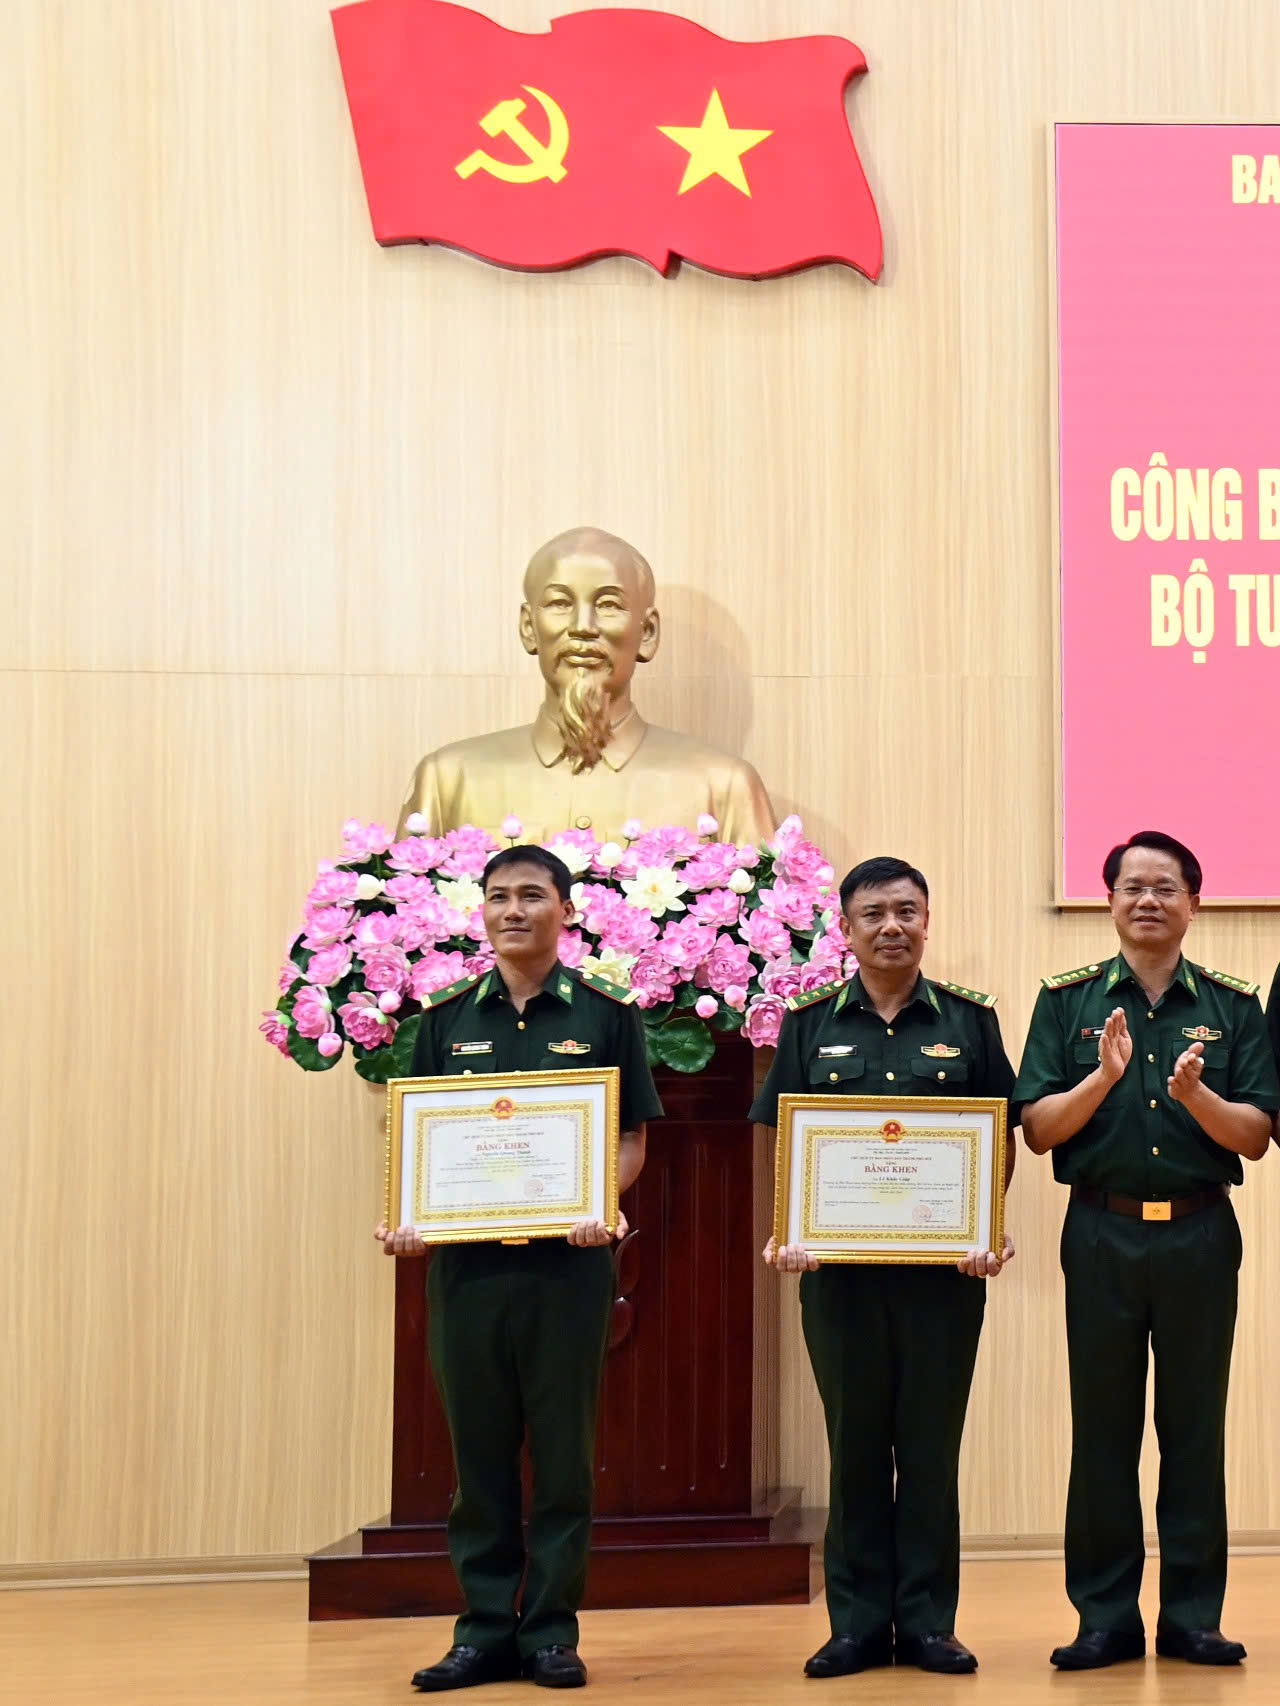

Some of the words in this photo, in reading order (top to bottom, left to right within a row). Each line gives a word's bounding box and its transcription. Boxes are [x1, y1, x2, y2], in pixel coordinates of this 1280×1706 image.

[1110, 451, 1243, 542] CÔNG
[1150, 558, 1215, 664] BỘ
[503, 1141, 531, 1150] KHEN
[891, 1166, 918, 1174] KHEN
